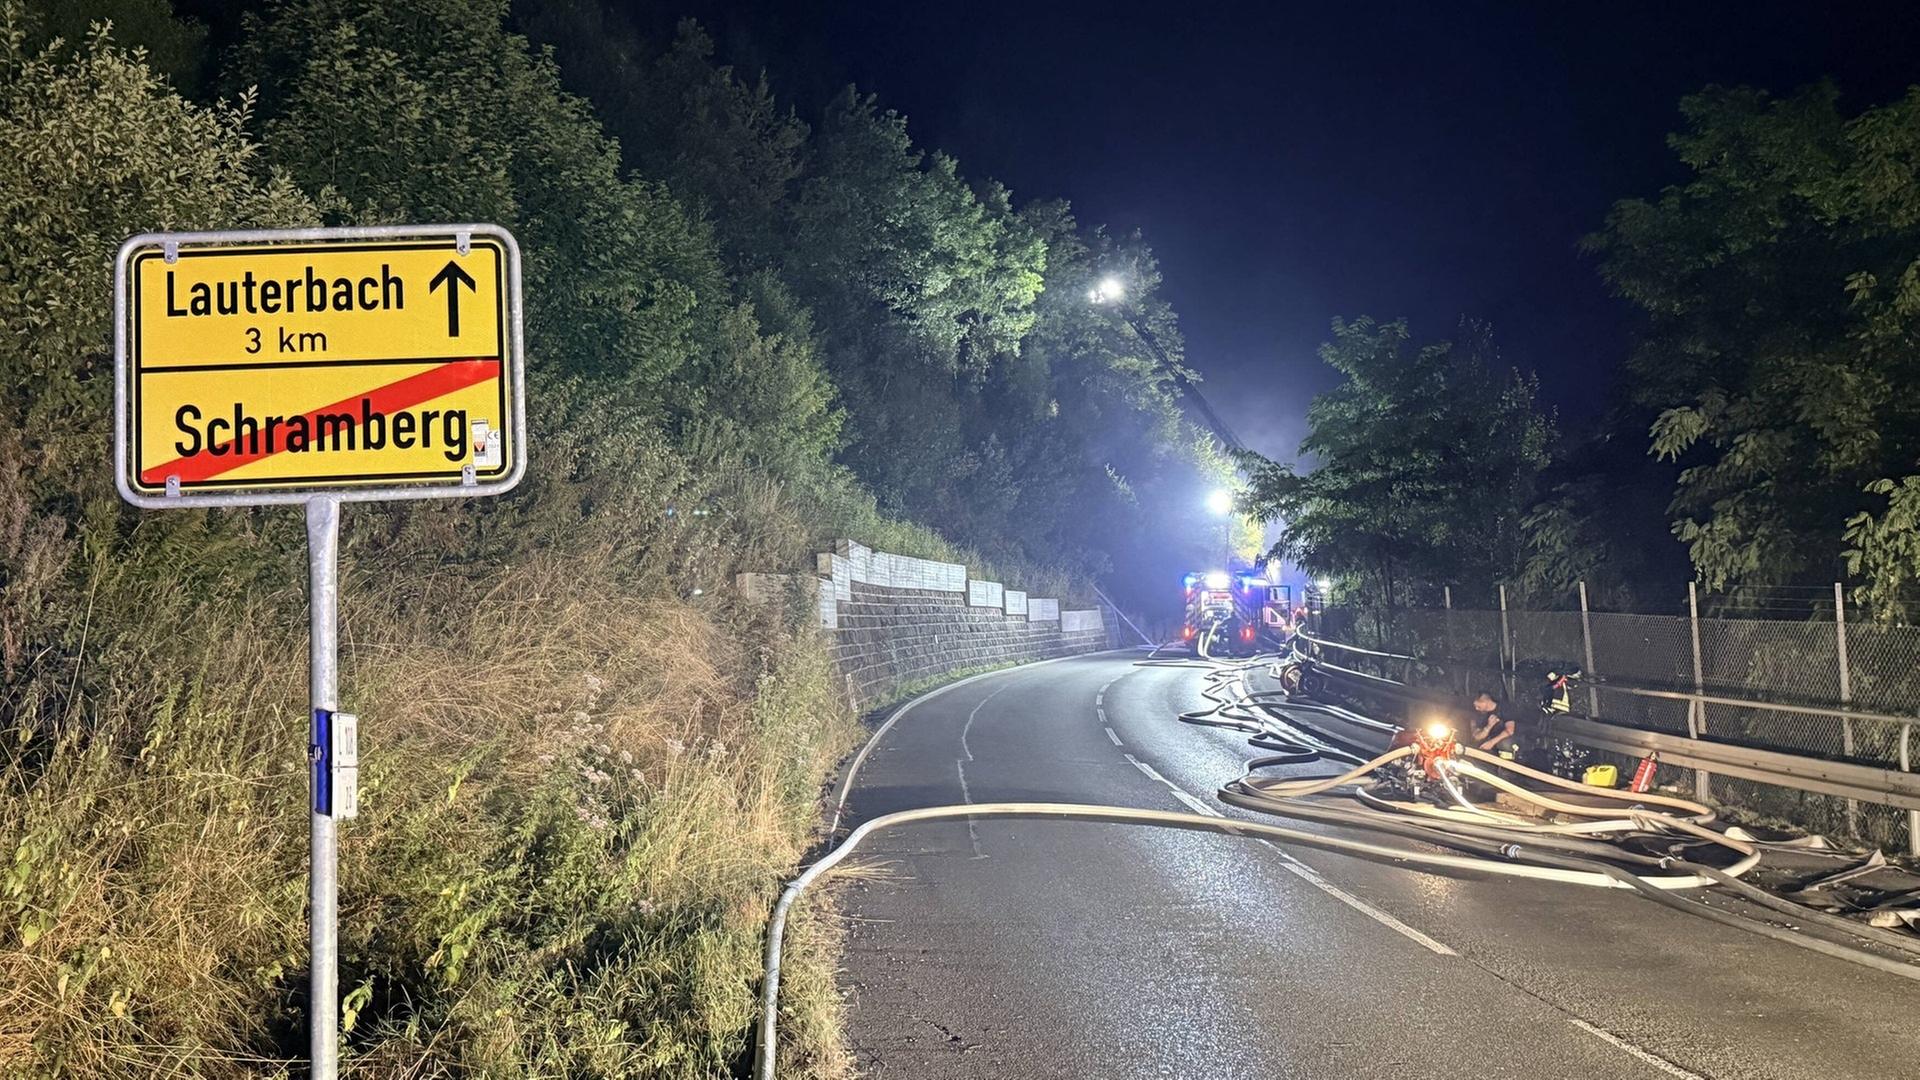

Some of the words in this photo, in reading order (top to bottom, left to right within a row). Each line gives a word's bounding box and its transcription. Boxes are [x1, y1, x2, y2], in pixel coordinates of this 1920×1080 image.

[166, 263, 404, 317] Lauterbach
[245, 327, 261, 354] 3
[279, 326, 327, 353] km
[175, 398, 467, 462] Schramberg
